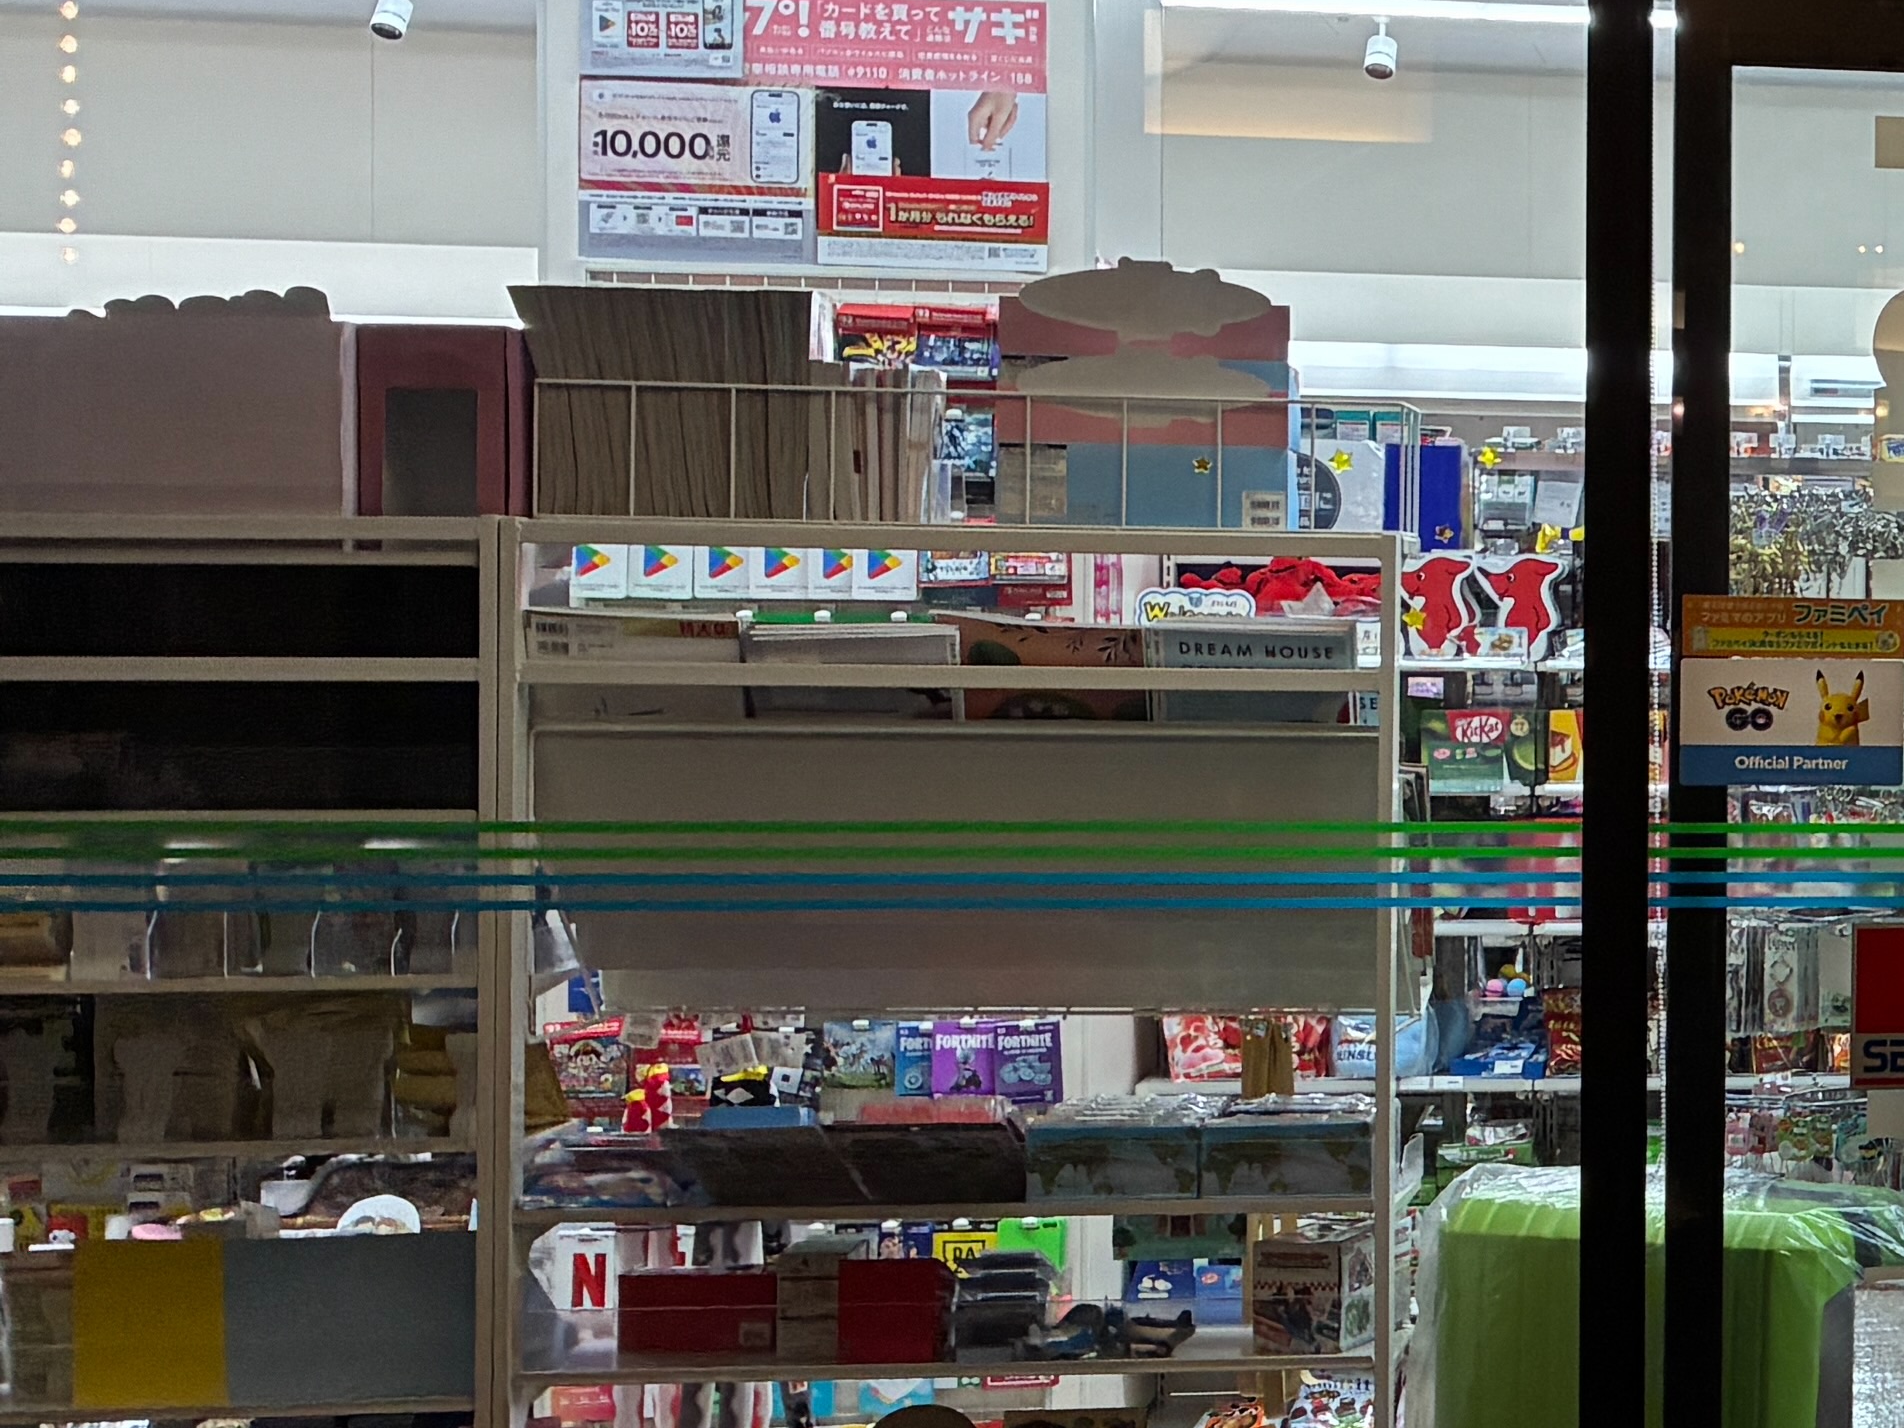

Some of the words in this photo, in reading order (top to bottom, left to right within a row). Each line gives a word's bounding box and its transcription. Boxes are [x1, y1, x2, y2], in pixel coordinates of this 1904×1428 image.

[819, 21, 921, 41] 番号教えて」
[598, 129, 712, 160] 10,000
[1793, 602, 1889, 626] ファミペイ
[1178, 641, 1253, 658] DREAM
[1264, 645, 1334, 660] HOUSE
[1725, 707, 1773, 731] GO
[1459, 715, 1503, 744] KitKat
[1734, 755, 1789, 770] Official
[1793, 755, 1848, 771] Partner
[935, 1034, 995, 1051] FORTNITE
[997, 1033, 1054, 1050] FORTNITE
